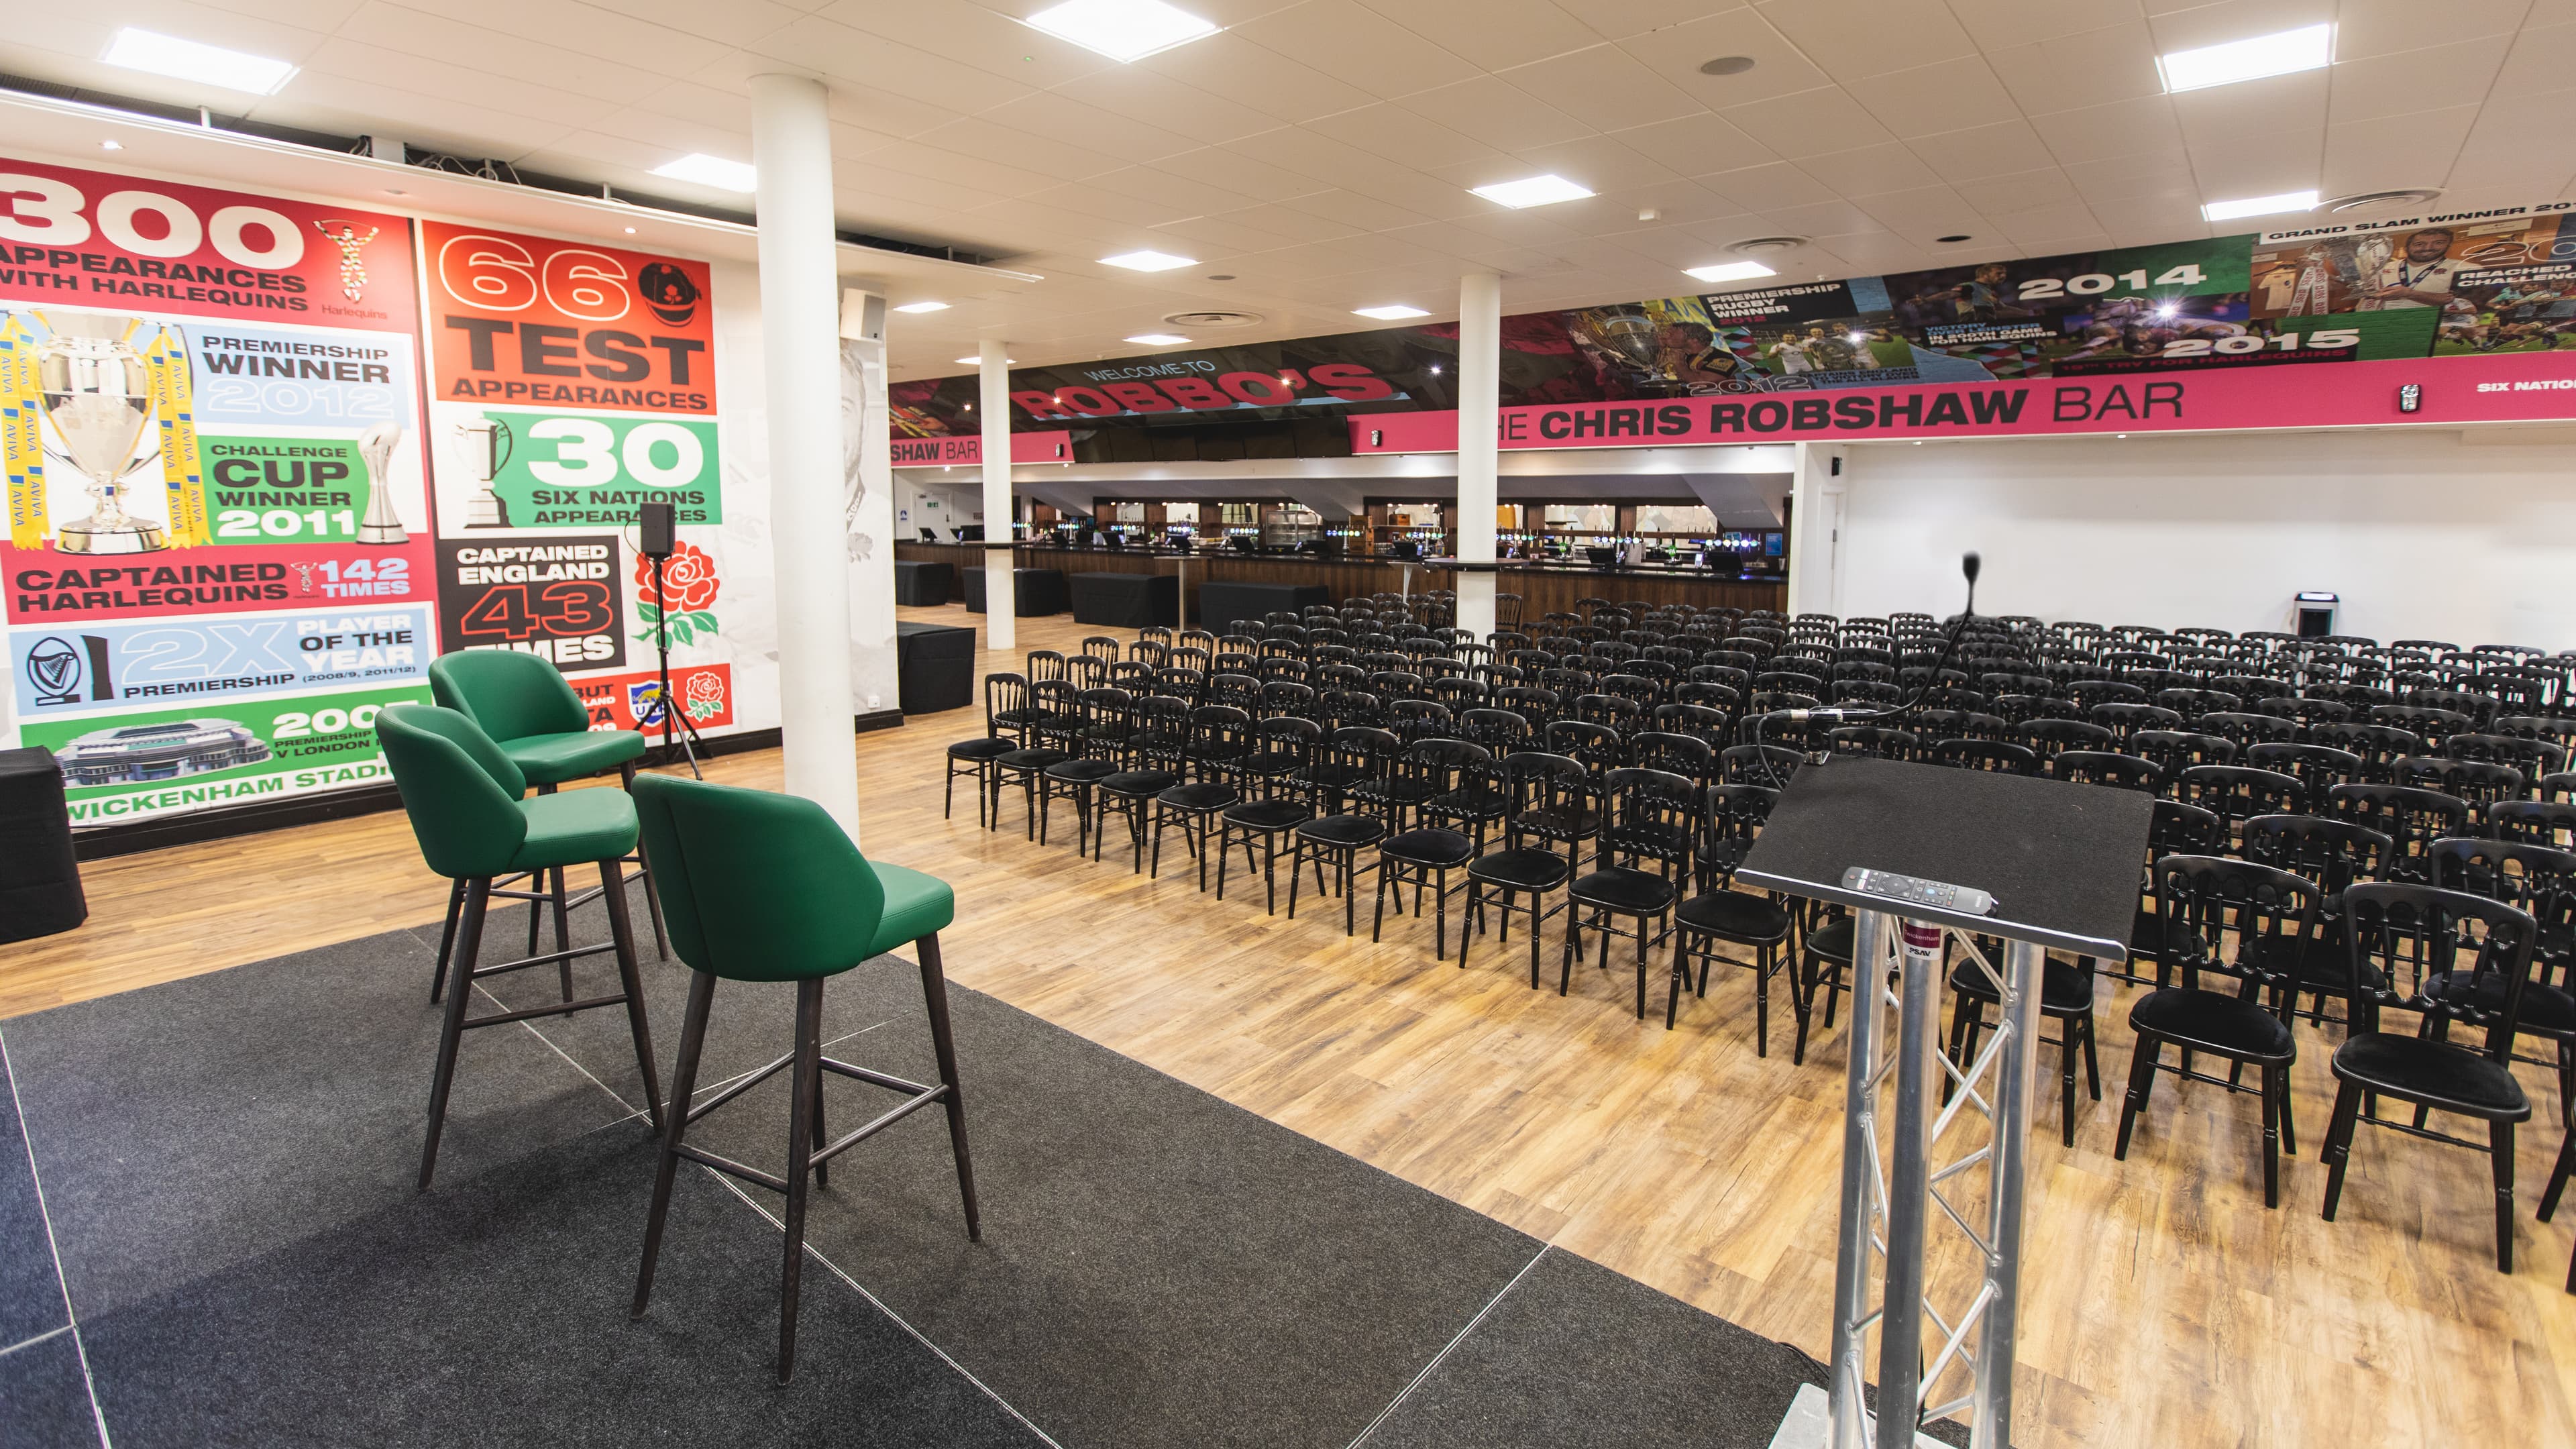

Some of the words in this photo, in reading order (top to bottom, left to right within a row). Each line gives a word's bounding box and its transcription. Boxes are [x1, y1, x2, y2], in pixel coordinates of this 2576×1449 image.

[0, 172, 305, 270] 300
[2269, 225, 2348, 240] GRAND
[2355, 218, 2420, 231] SLAM
[2427, 206, 2526, 223] WINNER
[2534, 203, 2576, 212] 20
[439, 235, 631, 321] 66
[2018, 264, 2206, 301] 2014
[2459, 265, 2572, 279] REACHED
[93, 277, 308, 311] HARLEQUINS
[1707, 283, 1841, 303] PREMIERSHIP
[1710, 299, 1776, 311] RUGBY
[322, 304, 388, 319] Harlequins
[1713, 305, 1790, 318] WINNER
[1719, 316, 1767, 325] 2012
[1925, 323, 1986, 331] VICTORY
[1962, 331, 2057, 343] HARLEQUINS
[1969, 323, 2040, 333] LEINSTER
[202, 336, 388, 360] PREMIERSHIP
[445, 314, 705, 386] TEST
[2163, 329, 2361, 358] 2015
[19, 350, 30, 385] AVIVA
[202, 352, 390, 384] WINNER
[1084, 363, 1186, 381] WELCOME
[1181, 360, 1216, 373] TO
[2106, 361, 2143, 369] TRY
[2149, 358, 2192, 366] FOR
[2199, 350, 2348, 364] HARLEQUINS
[1, 356, 13, 393] AVIVA
[156, 371, 167, 405] AVIVA
[172, 365, 185, 399] AVIVA
[1687, 376, 1811, 397] 2012
[2477, 382, 2510, 392] SIX
[2514, 379, 2576, 391] NATIO
[207, 378, 394, 419] 2012
[451, 378, 708, 410] APPEARANCES
[1010, 363, 1393, 420] ROBBO'S
[1540, 405, 1692, 439] CHRIS
[1710, 388, 2029, 433] ROBSHAW
[2053, 381, 2185, 422] BAR
[6, 424, 18, 460] AVIVA
[26, 416, 36, 451] AVIVA
[182, 428, 194, 462] AVIVA
[163, 435, 175, 468] AVIVA
[211, 444, 347, 458] CHALLENGE
[528, 418, 704, 488] 30
[946, 441, 977, 460] BAR
[213, 459, 350, 488] CUP
[13, 490, 25, 526] AVIVA
[32, 481, 42, 517] AVIVA
[191, 490, 203, 523] AVIVA
[215, 492, 351, 506] WINNER
[532, 490, 580, 504] SIX
[590, 490, 705, 505] NATIONS
[171, 496, 182, 529] AVIVA
[217, 510, 356, 537] 2011
[534, 509, 707, 523] APPEARAES
[457, 544, 608, 564] CAPTAINED
[15, 563, 286, 591] CAPTAINED
[319, 557, 410, 582] 142
[458, 562, 610, 586] ENGLAND
[17, 584, 288, 612] HARLEQUINS
[321, 580, 411, 598] TIMES
[460, 580, 613, 639] 43
[121, 621, 296, 686] 2X
[297, 614, 412, 636] PLAYER
[299, 635, 342, 651] OF
[352, 631, 413, 647] THE
[464, 635, 614, 663] MES
[301, 645, 414, 674] YEAR
[123, 674, 295, 699] PREMIERSHIP
[303, 671, 361, 683] (2008/9,
[364, 666, 417, 676] 2011/12)
[272, 700, 419, 739] 200
[274, 731, 372, 748] PREMIERSHIP
[276, 749, 288, 759] V
[294, 740, 370, 757] LONDON
[295, 765, 392, 788] STAD
[1909, 947, 1931, 957] PSAV
